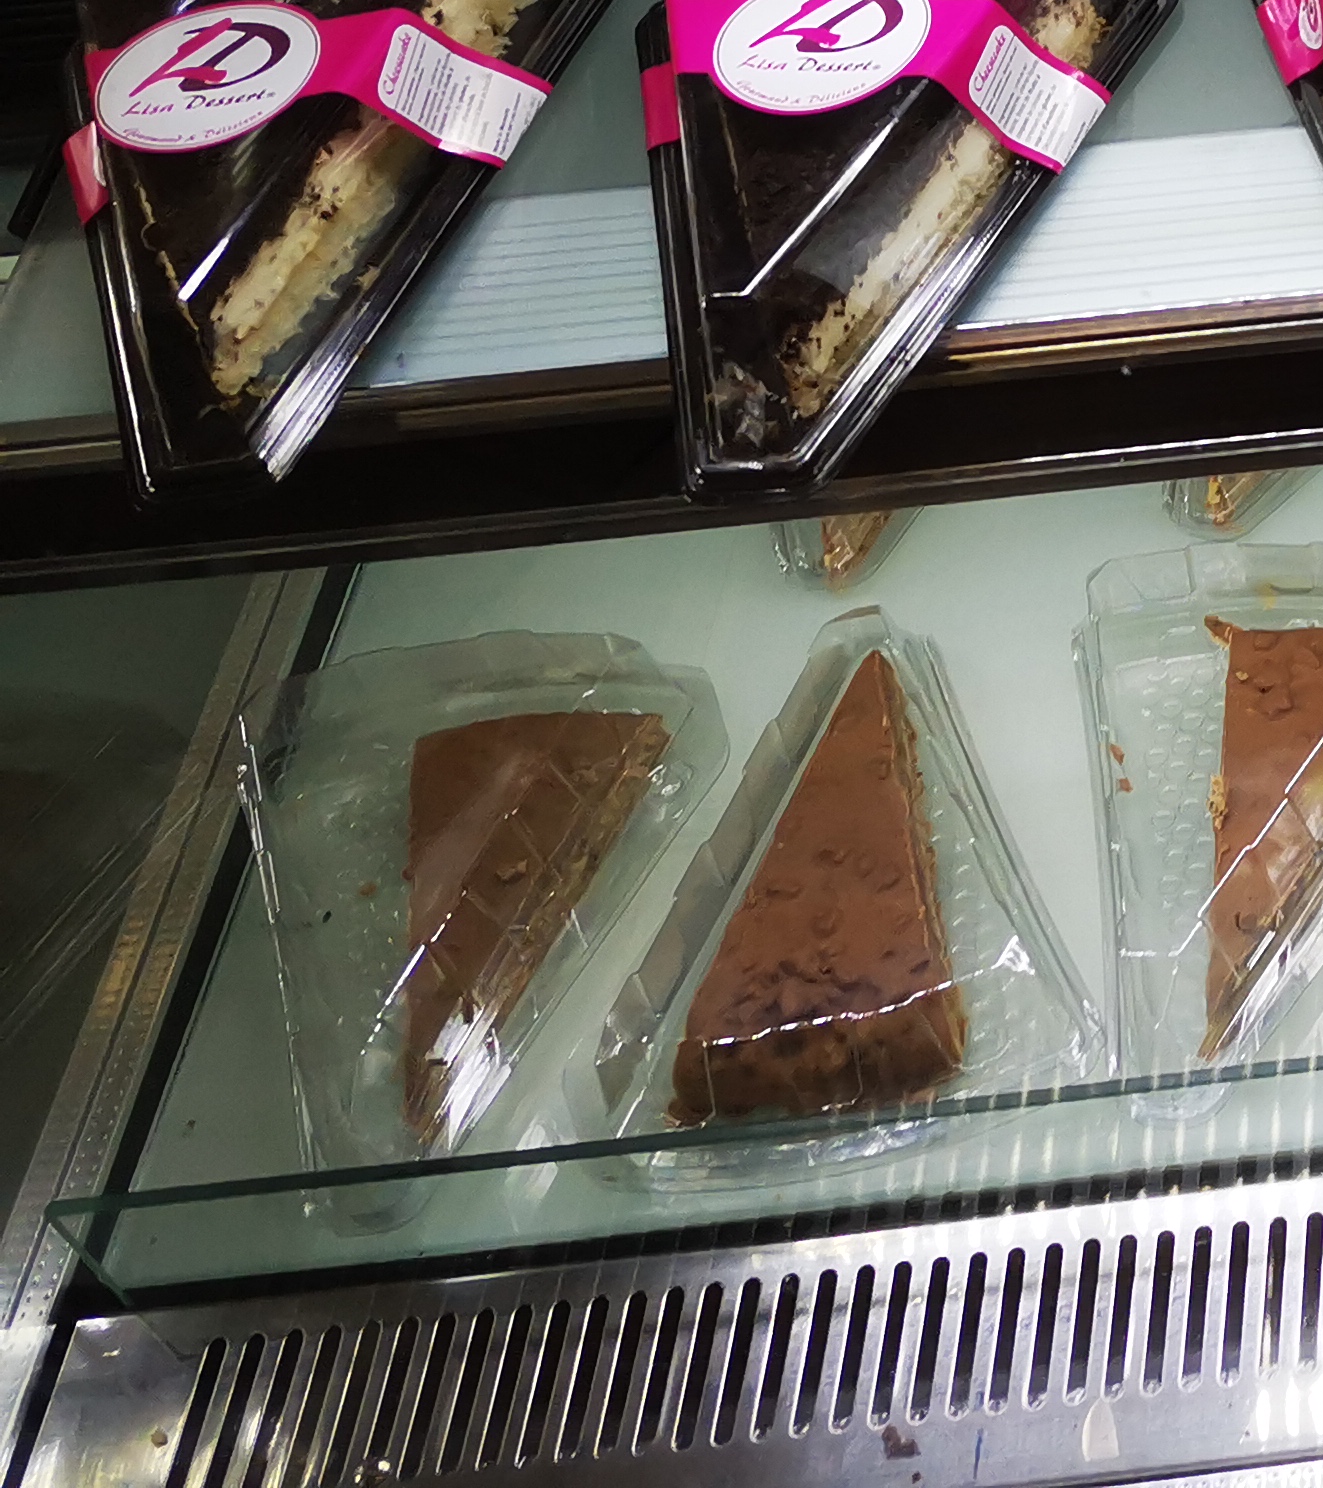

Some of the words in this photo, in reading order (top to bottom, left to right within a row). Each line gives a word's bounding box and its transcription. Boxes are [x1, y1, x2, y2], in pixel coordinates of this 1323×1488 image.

[737, 54, 788, 71] Lisa
[797, 57, 875, 72] Dessert
[121, 101, 174, 117] Lisa
[184, 89, 267, 110] Dessert
